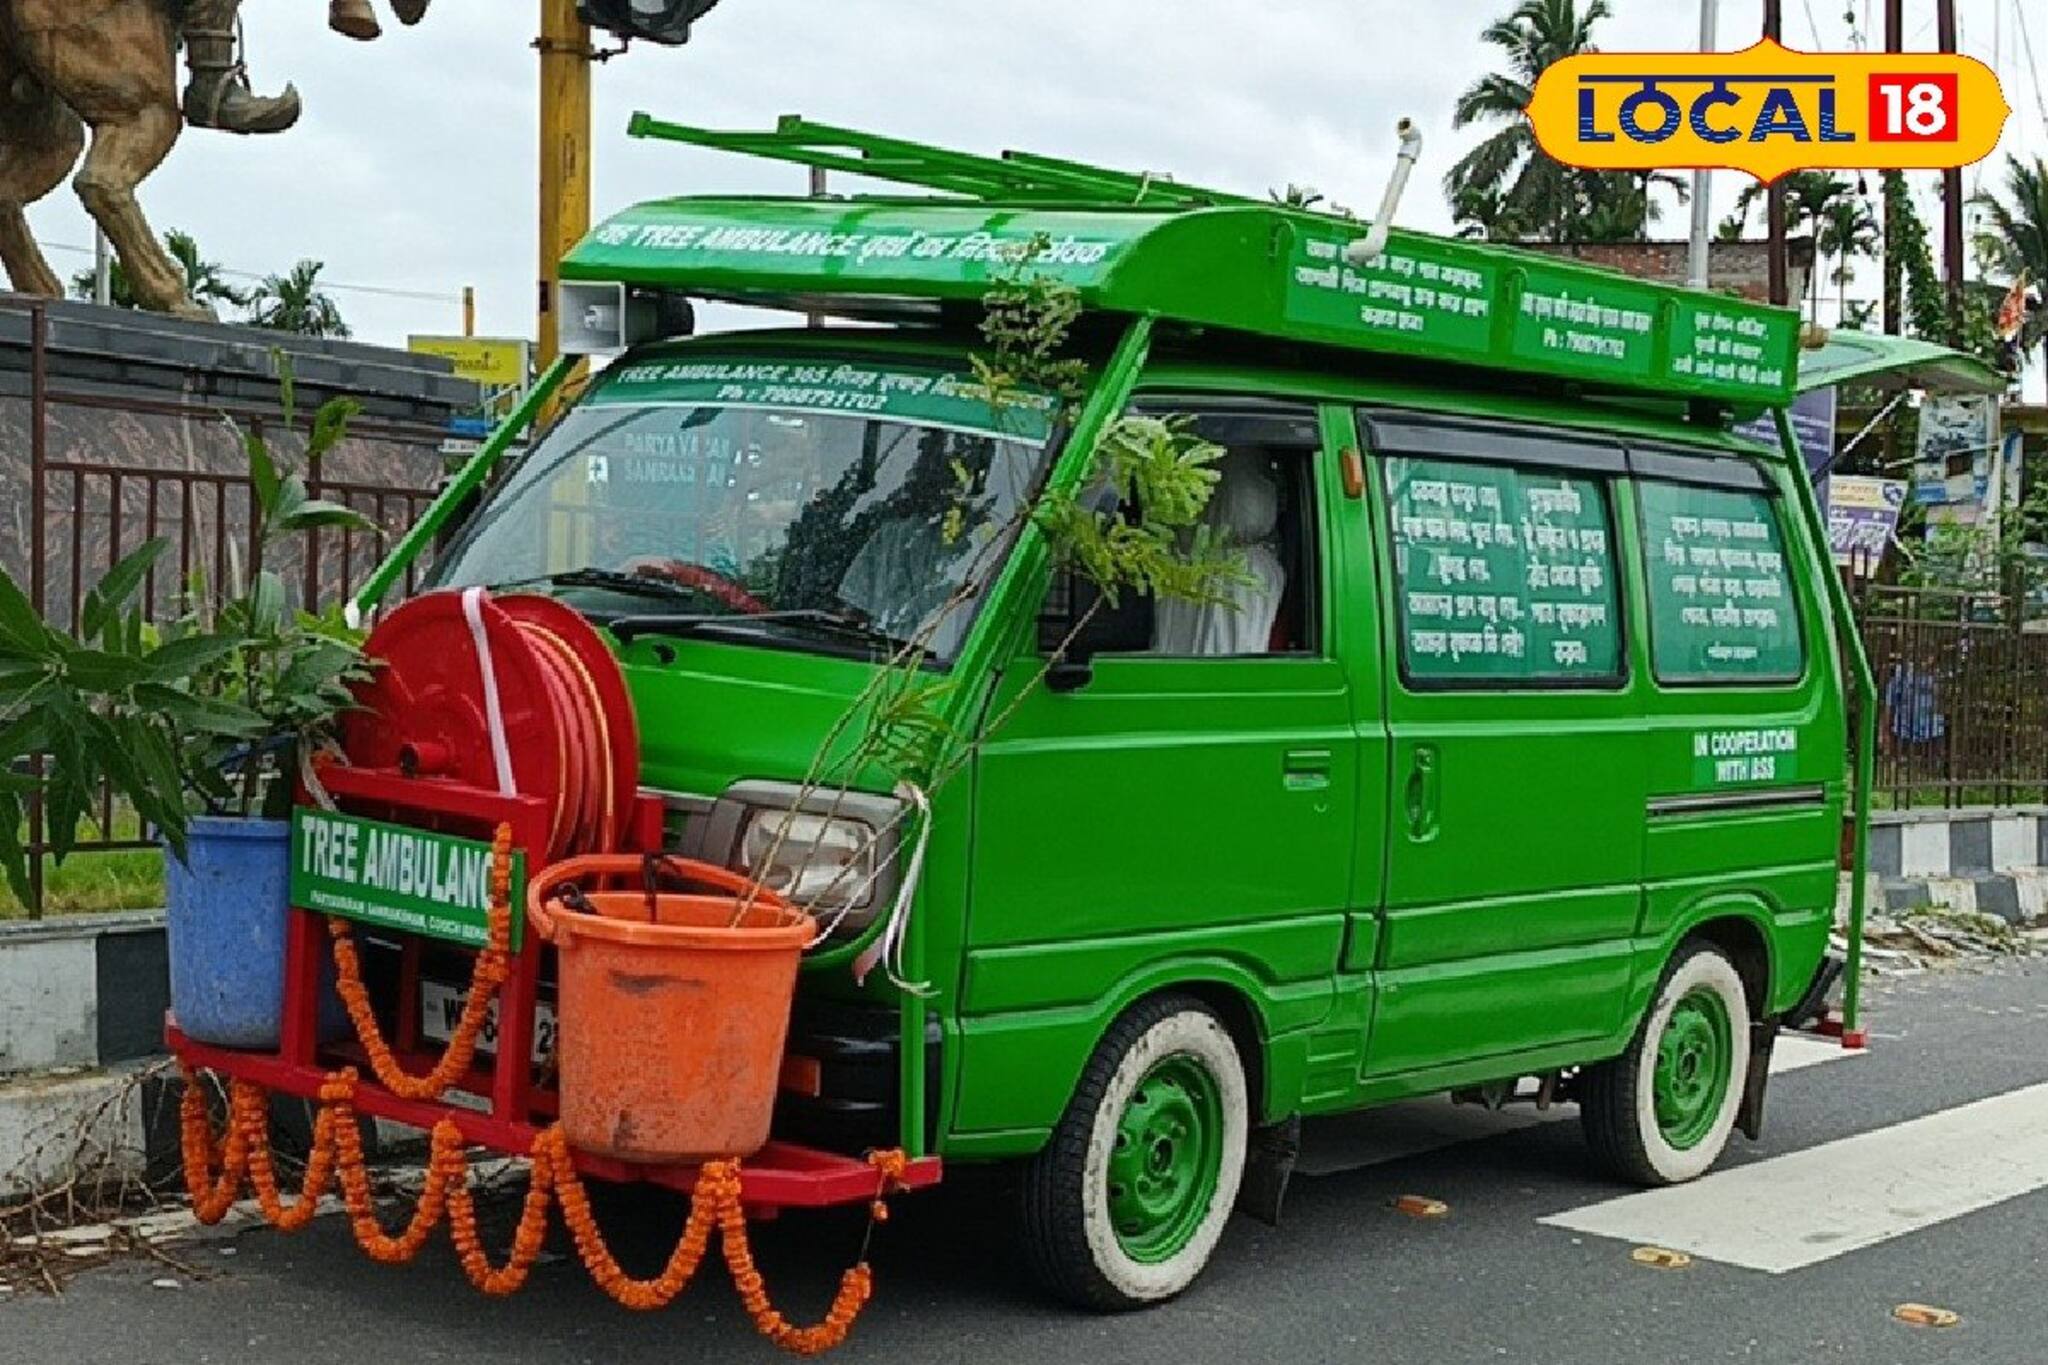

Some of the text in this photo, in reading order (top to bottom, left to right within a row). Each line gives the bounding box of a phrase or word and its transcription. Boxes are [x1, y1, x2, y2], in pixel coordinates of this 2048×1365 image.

[692, 226, 864, 256] AMBULANCE
[301, 814, 359, 884] TREE
[363, 827, 512, 911] AMBULANC
